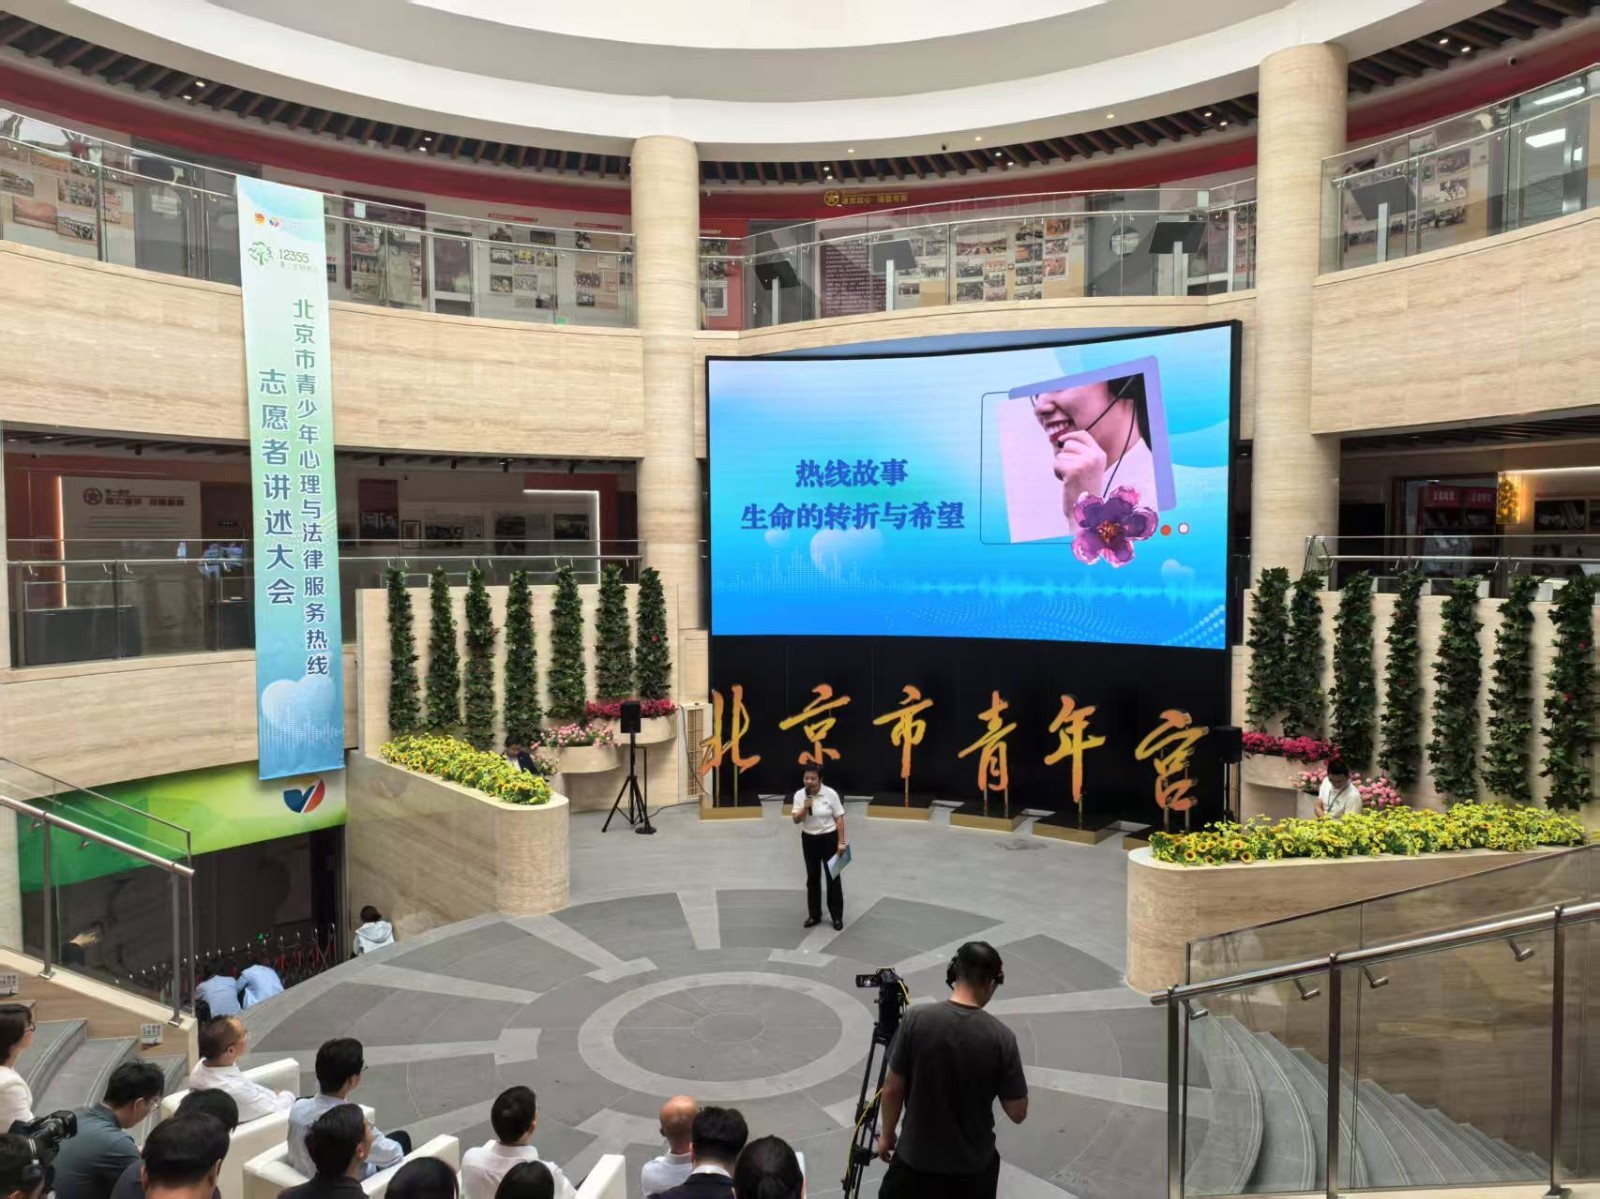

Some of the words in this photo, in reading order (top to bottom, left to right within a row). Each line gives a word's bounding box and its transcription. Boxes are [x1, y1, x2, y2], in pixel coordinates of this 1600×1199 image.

[279, 249, 309, 264] 12355
[258, 368, 296, 605] 志愿者讲述大会
[293, 298, 329, 676] 北京市青少年心理与法律服务热线
[795, 458, 909, 488] 热线故事
[740, 500, 966, 530] 生命的转折与希望
[698, 683, 1209, 811] 北京市青年宫
